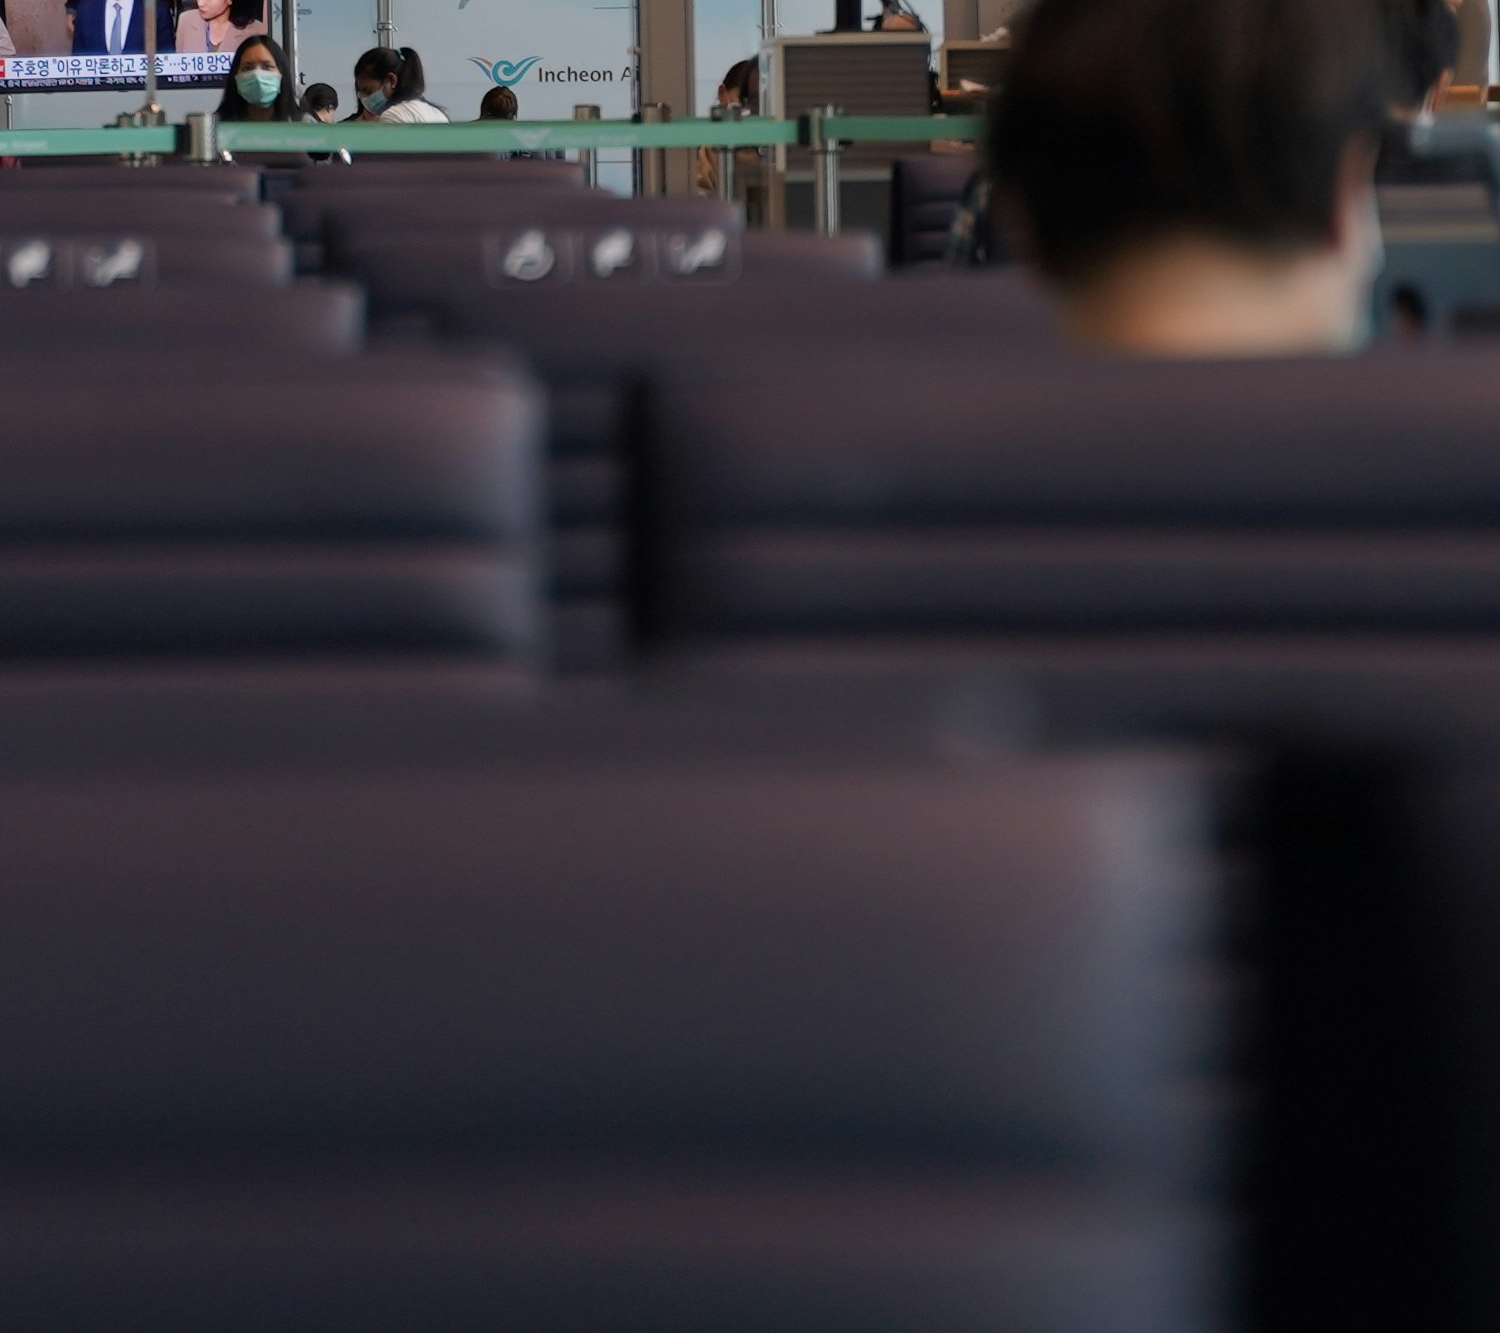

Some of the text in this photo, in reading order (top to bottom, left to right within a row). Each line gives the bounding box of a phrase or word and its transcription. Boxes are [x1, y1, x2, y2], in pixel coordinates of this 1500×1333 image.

[11, 59, 49, 77] 주호영
[85, 57, 136, 75] 막론하고
[539, 67, 613, 82] Incheon
